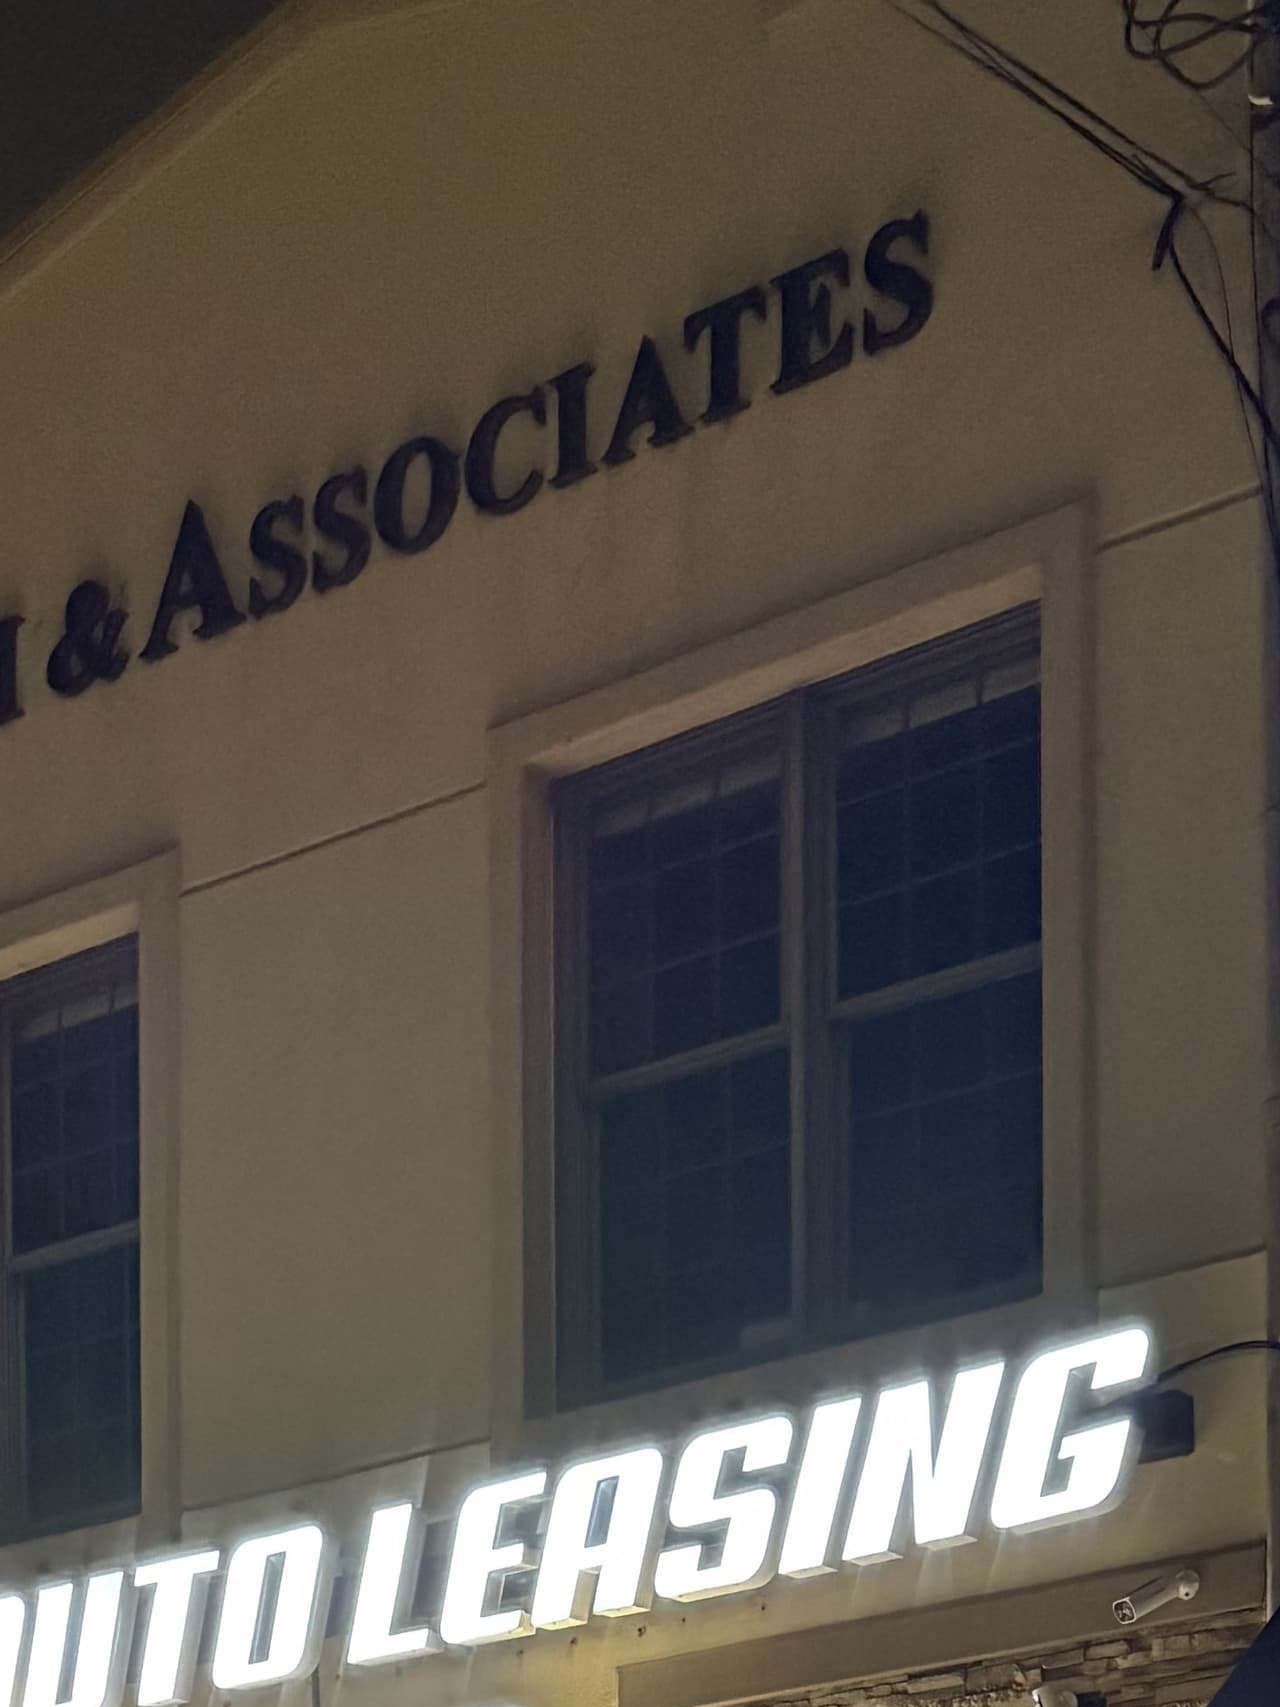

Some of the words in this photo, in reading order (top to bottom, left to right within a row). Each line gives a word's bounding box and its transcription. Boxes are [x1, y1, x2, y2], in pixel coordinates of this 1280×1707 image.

[46, 578, 130, 698] &
[140, 212, 934, 660] ASSOCIATES
[346, 1326, 1151, 1666] LEASING
